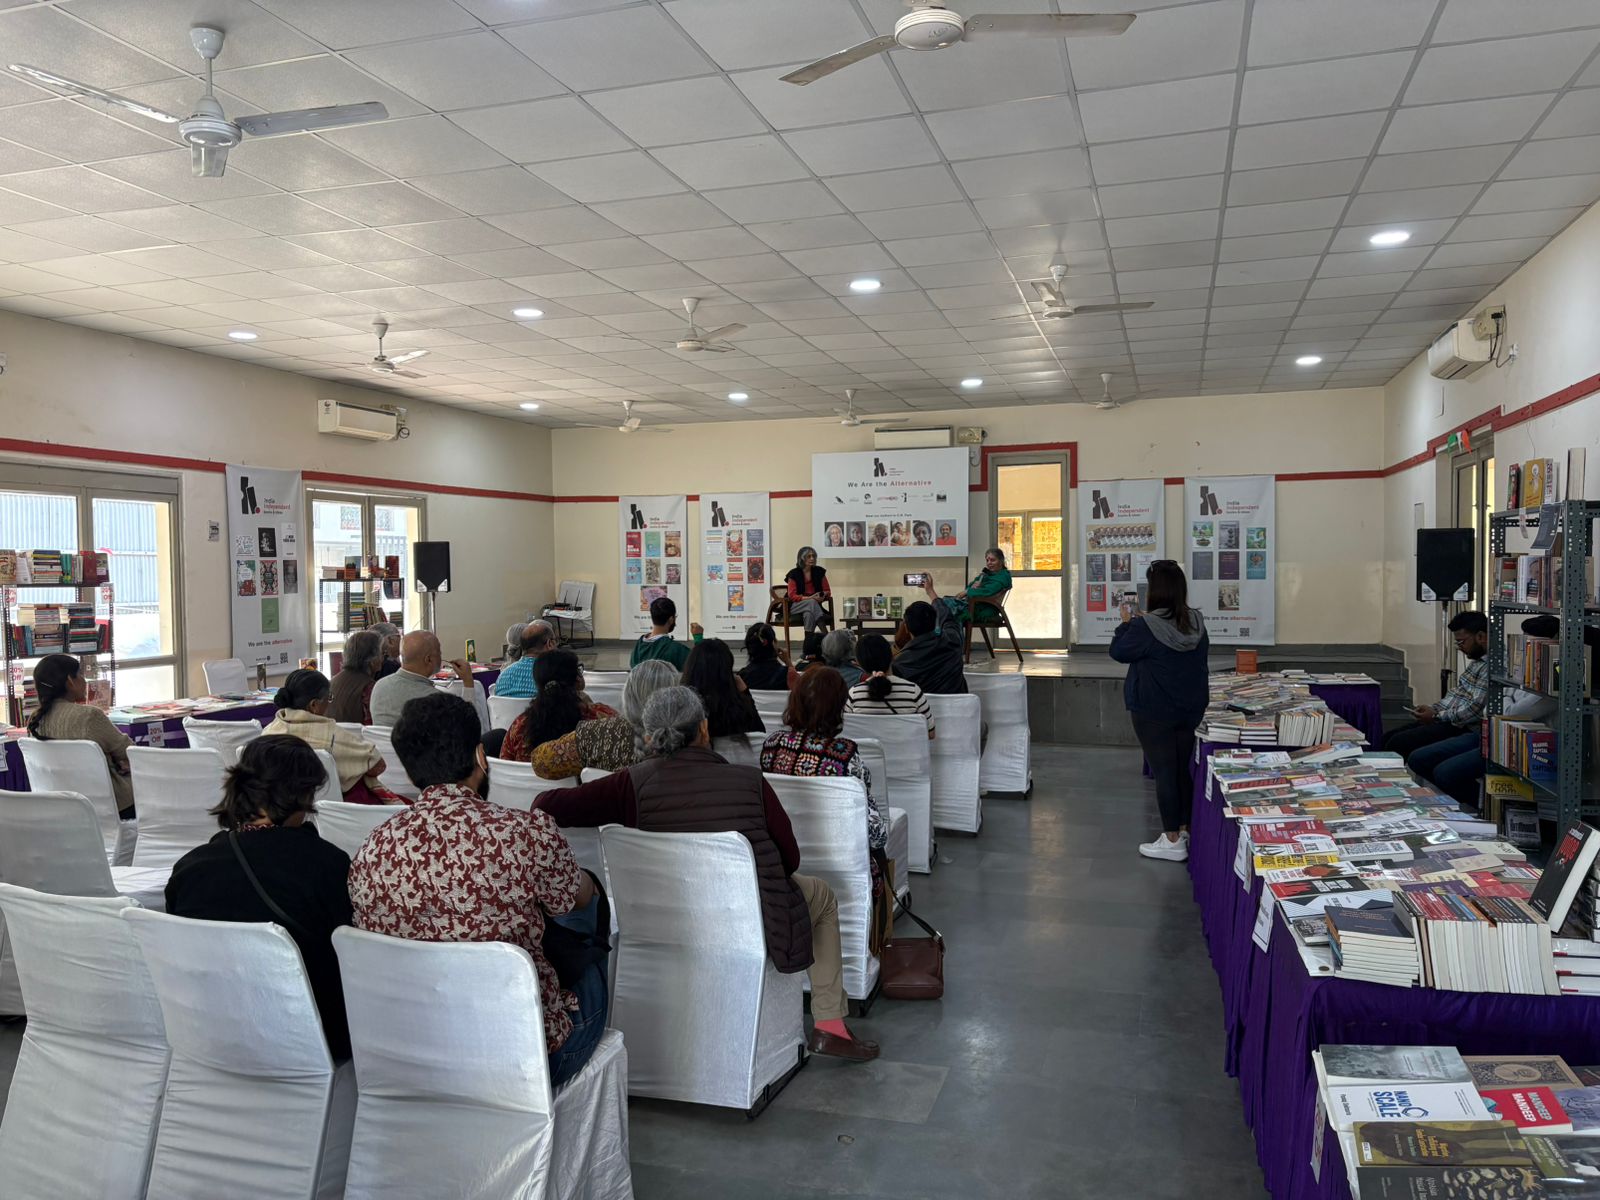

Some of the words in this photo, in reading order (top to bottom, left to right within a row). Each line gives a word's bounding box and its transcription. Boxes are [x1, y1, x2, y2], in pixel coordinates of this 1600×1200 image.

[890, 479, 932, 487] Alternative
[150, 727, 162, 735] 20%
[1373, 1090, 1402, 1118] SCALE
[1393, 1090, 1412, 1107] NANO
[1512, 1092, 1537, 1122] MANDEEP
[1527, 1091, 1553, 1121] MANDEEP
